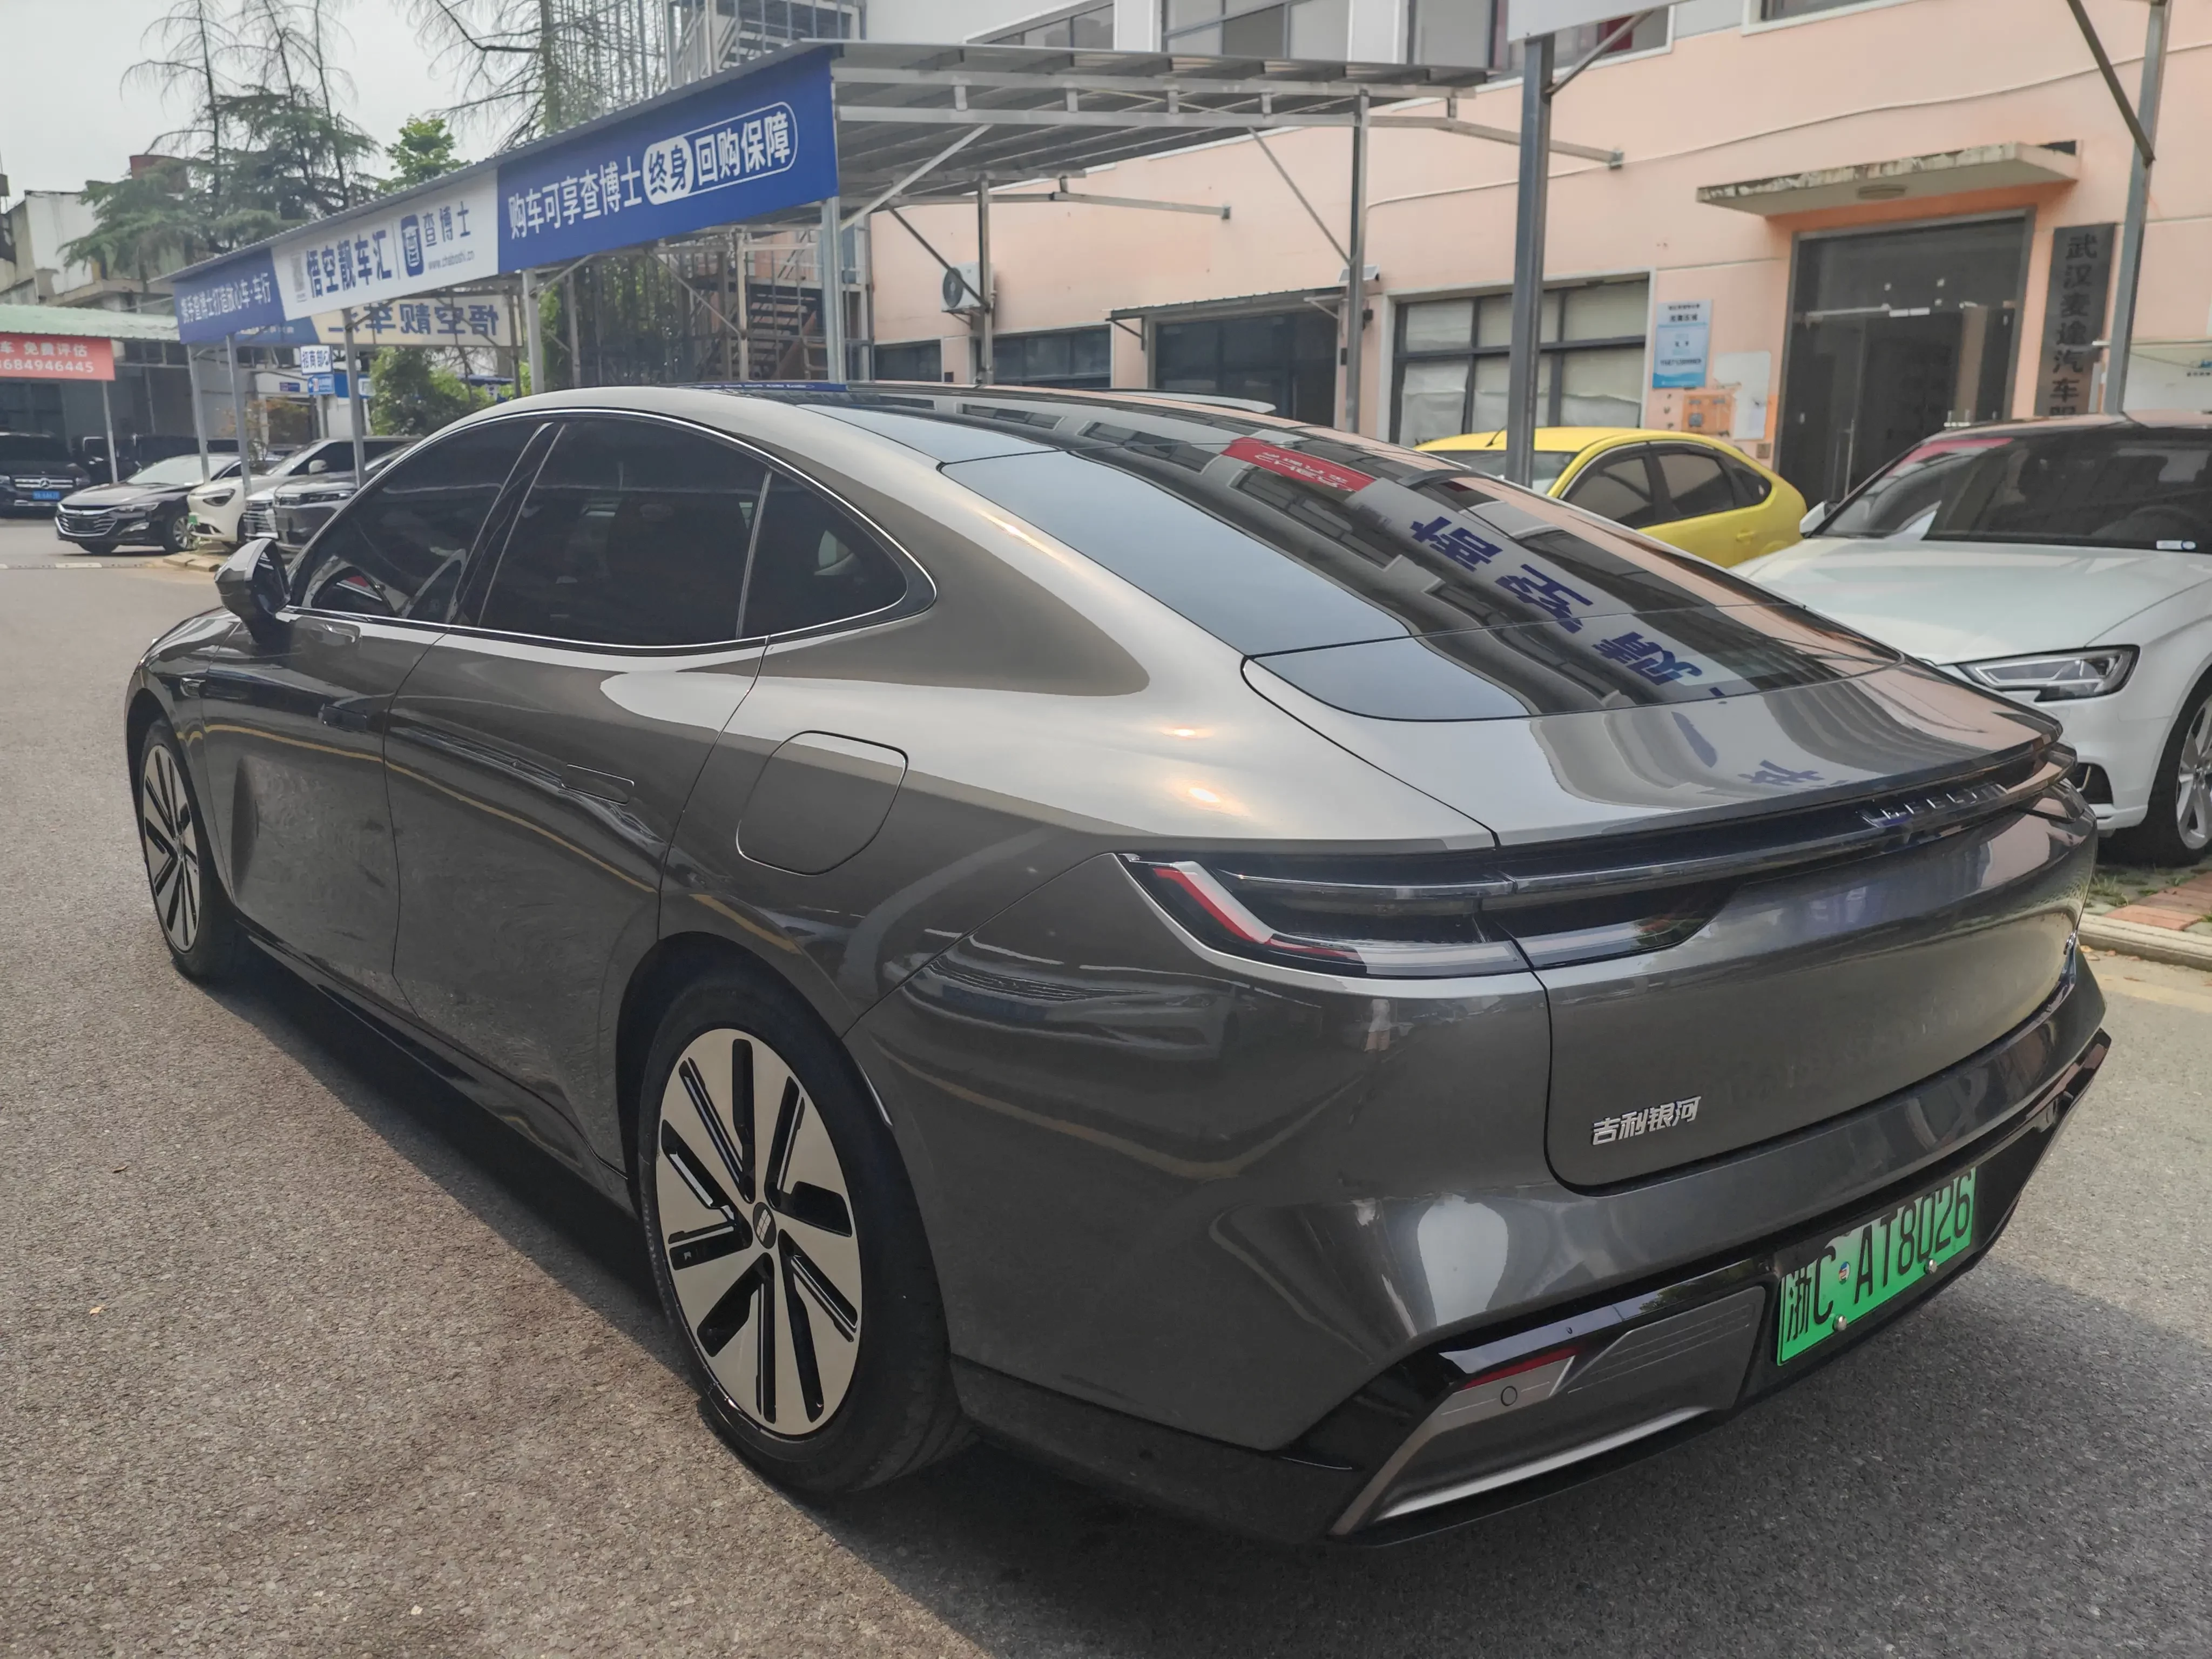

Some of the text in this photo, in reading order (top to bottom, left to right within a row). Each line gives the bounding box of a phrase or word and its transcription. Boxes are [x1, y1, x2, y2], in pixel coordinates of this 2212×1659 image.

[423, 201, 471, 247] 查博士
[306, 229, 392, 298] 悟空靓车汇
[0, 359, 94, 373] 684946445
[1592, 1096, 1702, 1145] 吉利银河
